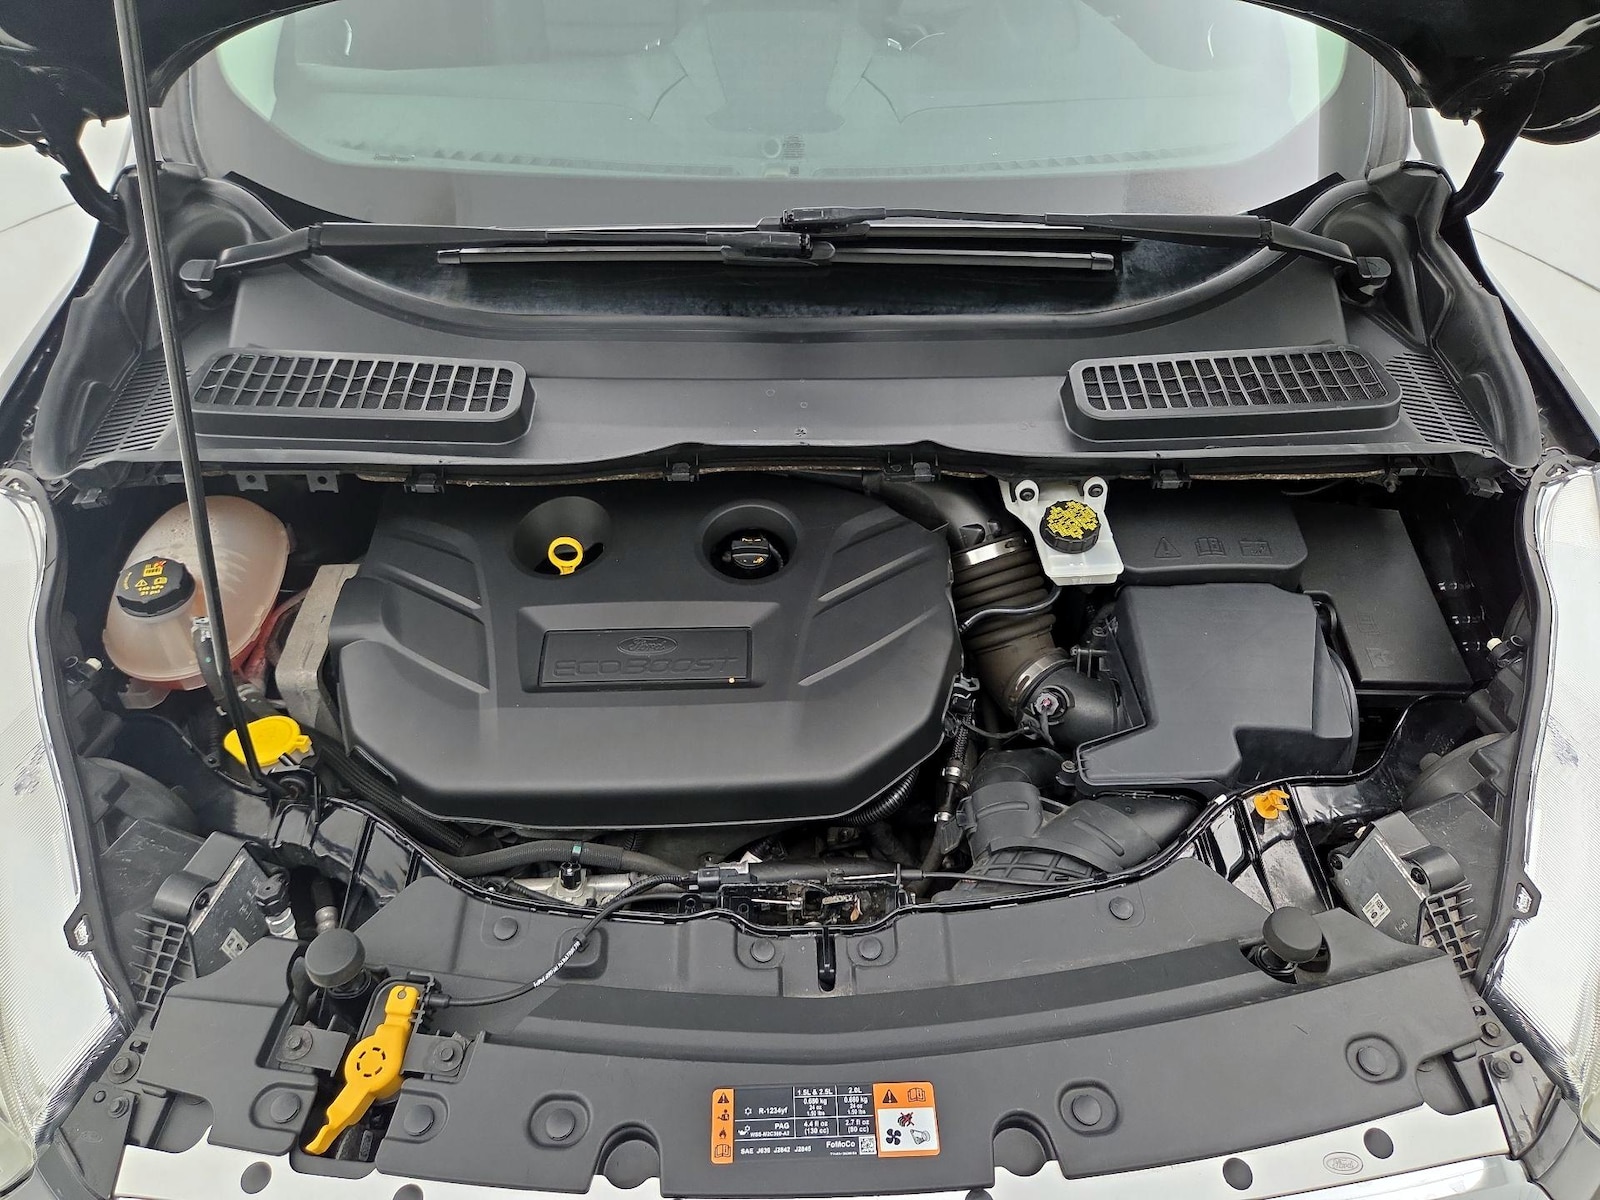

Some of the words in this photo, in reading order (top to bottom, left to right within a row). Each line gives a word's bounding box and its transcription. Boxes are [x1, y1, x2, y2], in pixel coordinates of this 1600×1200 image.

[860, 1096, 868, 1104] kg
[758, 1106, 788, 1115] R-1234yf
[774, 1122, 790, 1130] PAG
[819, 1126, 829, 1134] cc)
[859, 1125, 870, 1133] cc)
[826, 1140, 856, 1149] FoMoCo
